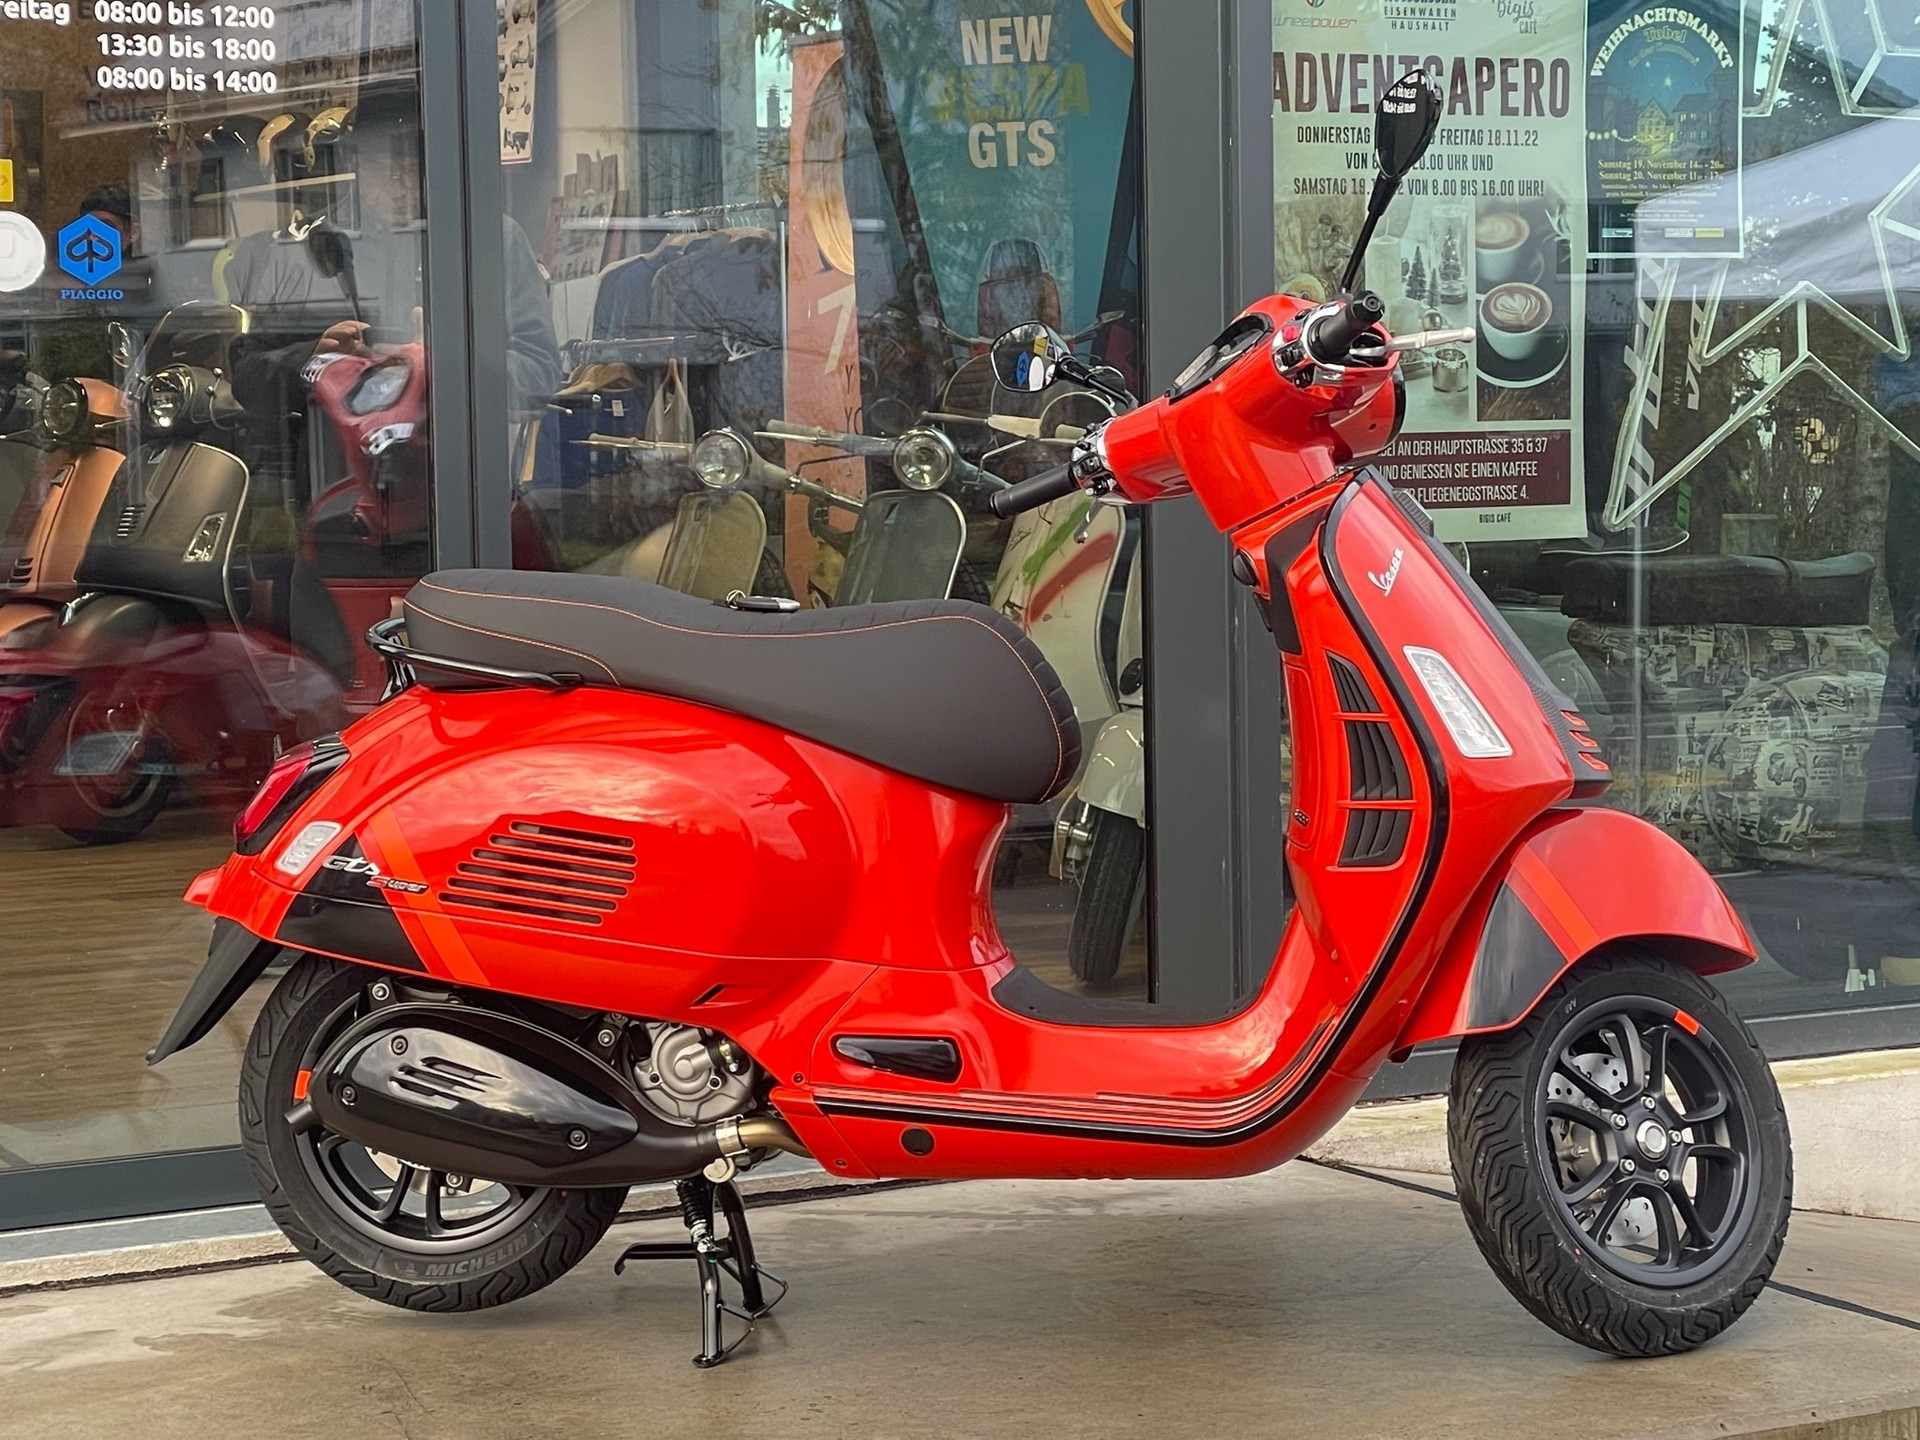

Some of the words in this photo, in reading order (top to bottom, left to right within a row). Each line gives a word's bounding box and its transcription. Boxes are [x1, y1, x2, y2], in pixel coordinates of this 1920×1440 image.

[94, 0, 162, 25] 08:00
[167, 1, 204, 26] bis
[210, 5, 275, 29] 12:00
[1384, 6, 1457, 18] EISENWAREN
[1391, 20, 1450, 32] HAUSHALT
[1643, 26, 1687, 44] Tobel
[96, 33, 163, 57] 13:30
[169, 34, 206, 59] bis
[211, 38, 276, 61] 18:00
[960, 14, 1051, 66] NEW
[1590, 7, 1734, 76] WEIHNACHTSMARKT
[97, 65, 164, 90] 08:00
[170, 66, 207, 92] bis
[212, 70, 278, 94] 14:00
[968, 120, 1056, 168] GTS
[1297, 126, 1371, 144] DONNERSTAG
[1440, 129, 1484, 146] FREITAG
[1487, 129, 1539, 147] 18.11.22
[1345, 152, 1368, 169] VON
[1447, 154, 1469, 171] UHR
[1472, 154, 1493, 171] UND
[1598, 160, 1632, 170] Samstag
[1647, 160, 1687, 169] November
[1599, 171, 1632, 181] Sonntag
[1647, 171, 1687, 180] November
[1294, 177, 1347, 195] SAMSTAG
[1408, 179, 1428, 196] VON
[1432, 179, 1457, 196] 8.00
[1461, 179, 1478, 196] BIS
[1482, 179, 1514, 197] 16.00
[1518, 180, 1544, 197] UHR!
[60, 289, 124, 300] PIAGGIO
[1397, 440, 1412, 457] AN
[1413, 440, 1432, 456] DER
[1433, 438, 1509, 456] HAUPTSTRASSE
[1511, 438, 1525, 453] 35
[1535, 437, 1548, 453] 37
[1380, 464, 1399, 480] UND
[1400, 463, 1452, 480] GENIESSEN
[1454, 462, 1470, 479] SIE
[1471, 462, 1500, 478] EINEN
[1501, 460, 1538, 477] KAFFEE
[1417, 484, 1518, 503] FLIEGENEGGSTRASSE
[1519, 484, 1529, 500] 4.
[1479, 514, 1495, 524] BIGIS
[1497, 512, 1512, 523] CAFÉ
[425, 1231, 530, 1276] MICHELIN
